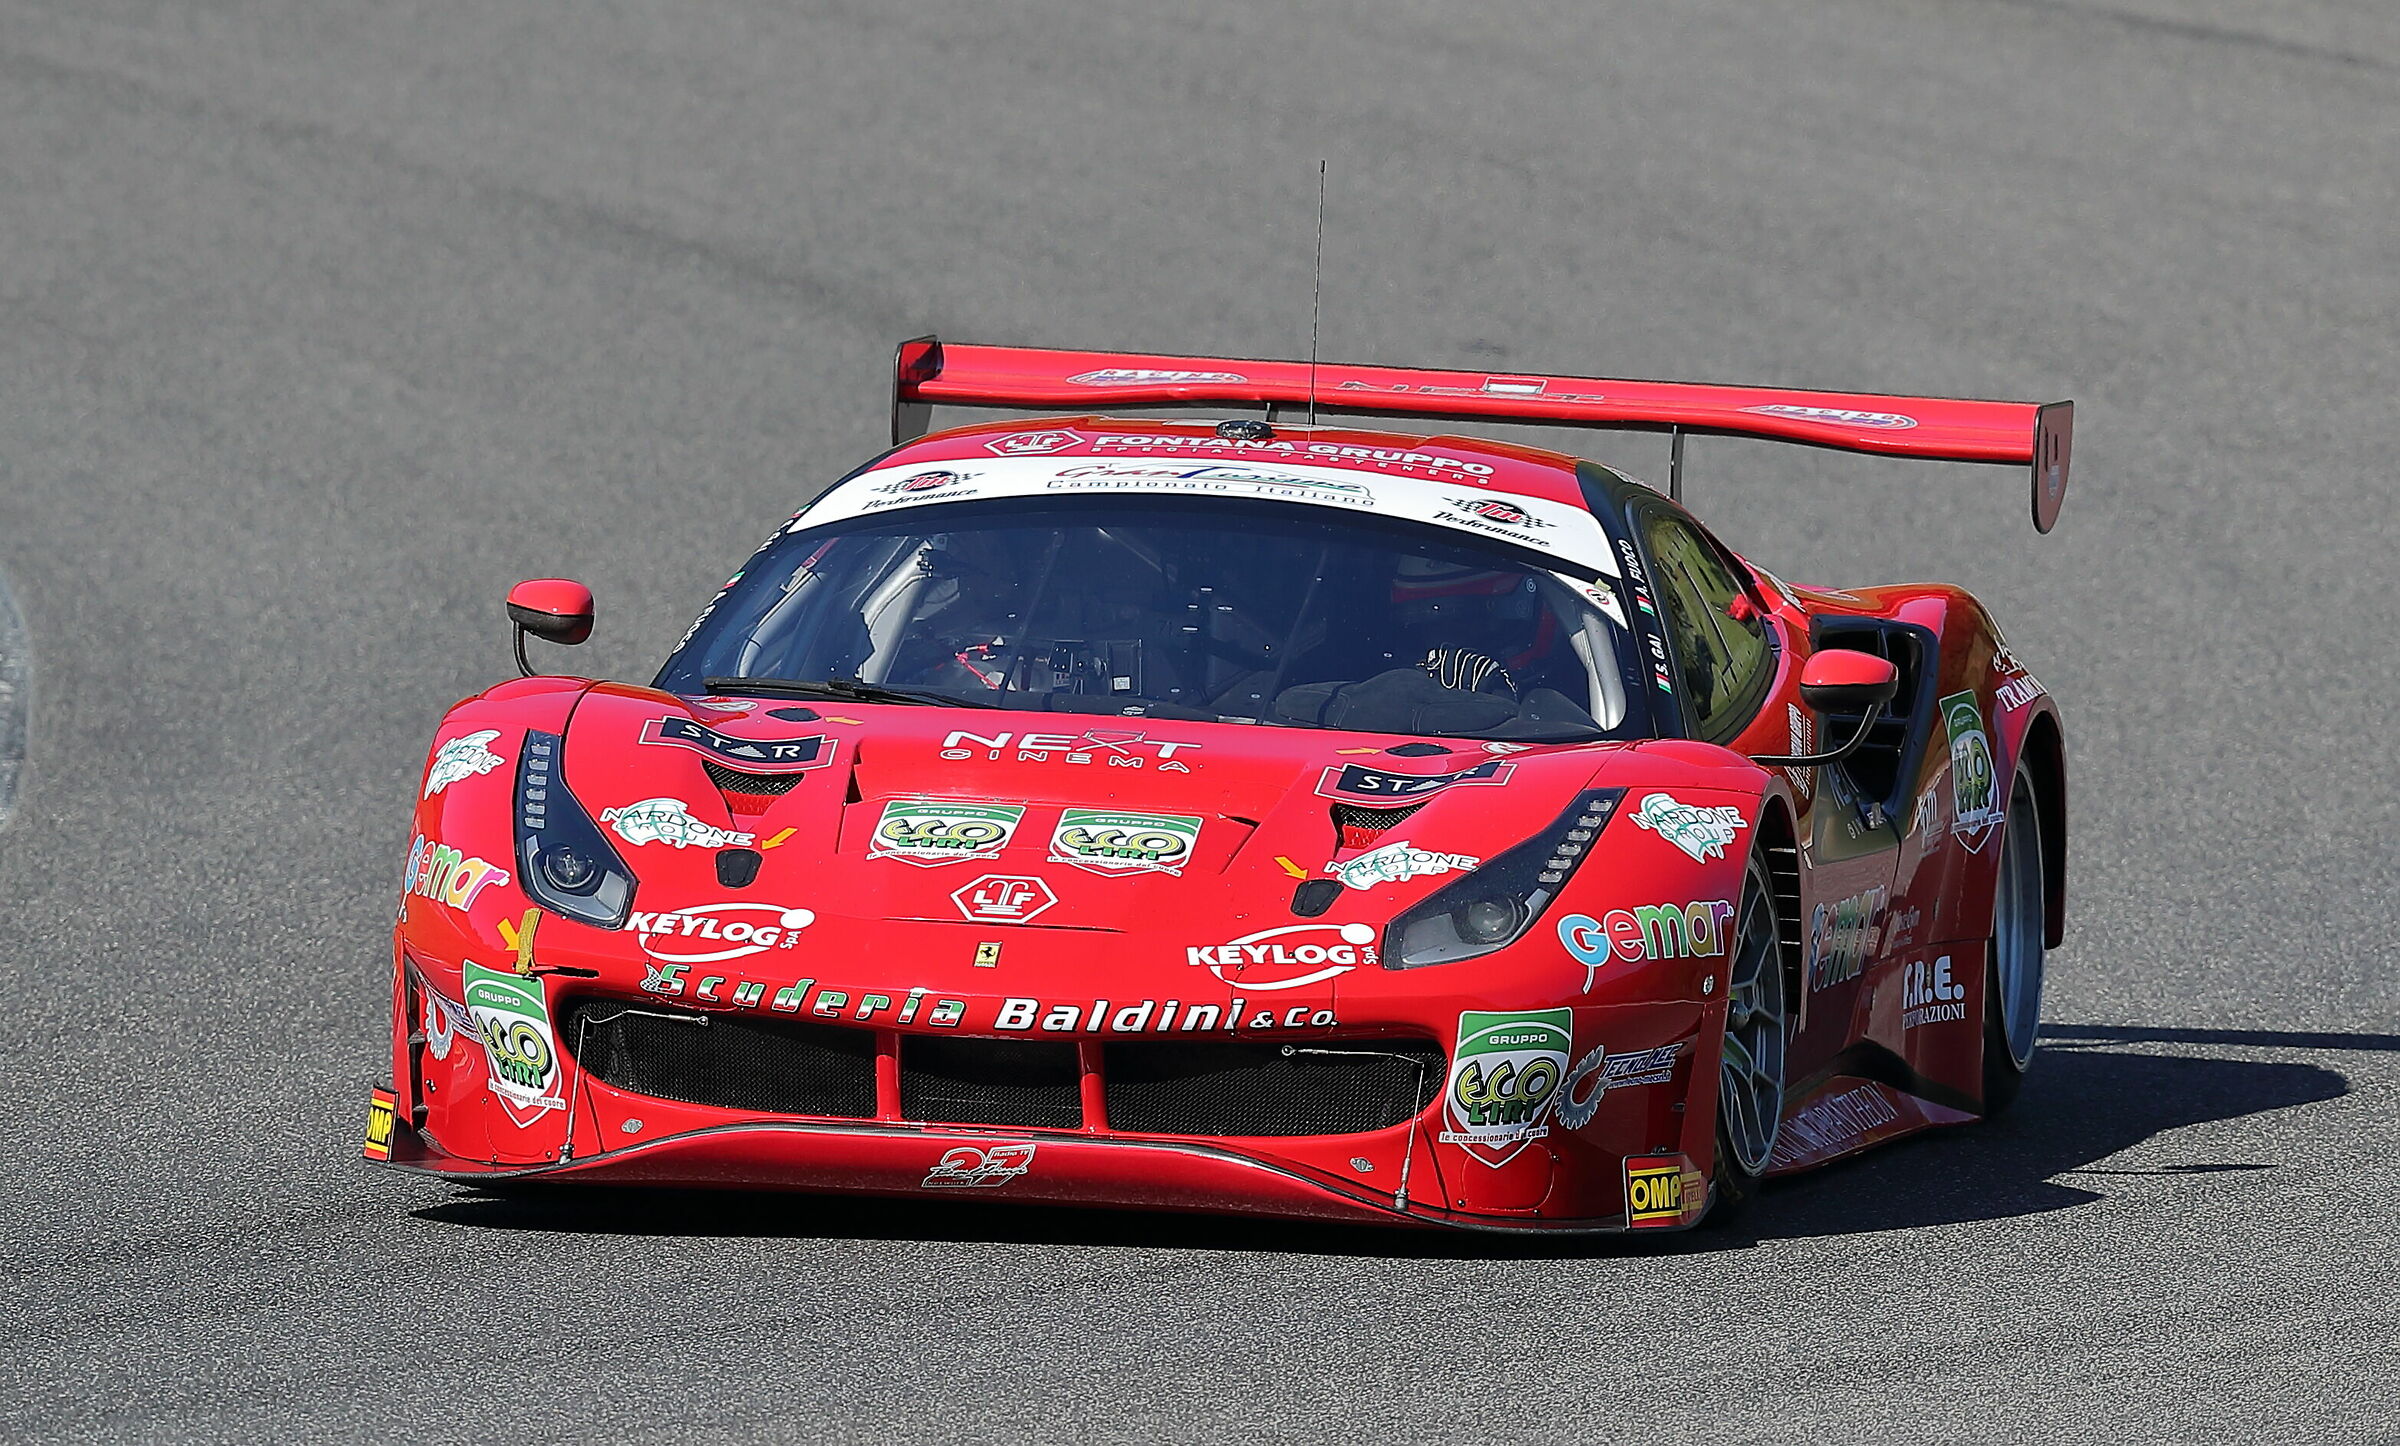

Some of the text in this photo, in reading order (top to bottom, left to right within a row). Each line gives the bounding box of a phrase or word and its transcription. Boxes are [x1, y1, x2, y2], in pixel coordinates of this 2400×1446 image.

[1090, 446, 1489, 485] SPECIAL FASTENERS
[1094, 435, 1495, 476] FONTANA GRUPPO
[861, 489, 978, 511] Performance
[1046, 480, 1375, 507] Campionato Italiano
[1432, 510, 1551, 548] Performance
[1618, 539, 1645, 583] FUOCO
[1647, 633, 1670, 677] S. GAI
[941, 727, 1203, 760] NEXT
[939, 749, 1192, 775] CINEMA
[604, 808, 752, 846] NARDONE
[916, 808, 989, 817] GRUPPO
[1094, 817, 1167, 828] GRUPPO
[1632, 806, 1746, 829] NARDONE
[896, 836, 981, 850] LIRI
[1660, 827, 1736, 841] GROUP
[1077, 844, 1162, 861] LIRI
[1328, 851, 1479, 874] NARDONE
[403, 833, 511, 913] Gemar
[623, 911, 803, 950] KEYLOG SpA
[1556, 899, 1735, 968] Gemar
[1187, 943, 1380, 966] KEYLOG SpA
[477, 988, 522, 1007] GRUPPO
[639, 963, 967, 1027] Scuderia
[992, 996, 1246, 1033] Baldini
[1248, 1010, 1274, 1029] &
[1488, 1032, 1549, 1047] GRUPPO
[498, 1057, 546, 1090] LIRI
[366, 1106, 393, 1144] OMP
[1467, 1098, 1538, 1128] LIRI
[1441, 1132, 1450, 1141] le
[1452, 1131, 1514, 1143] concessionarie
[1630, 1174, 1681, 1211] OMP
